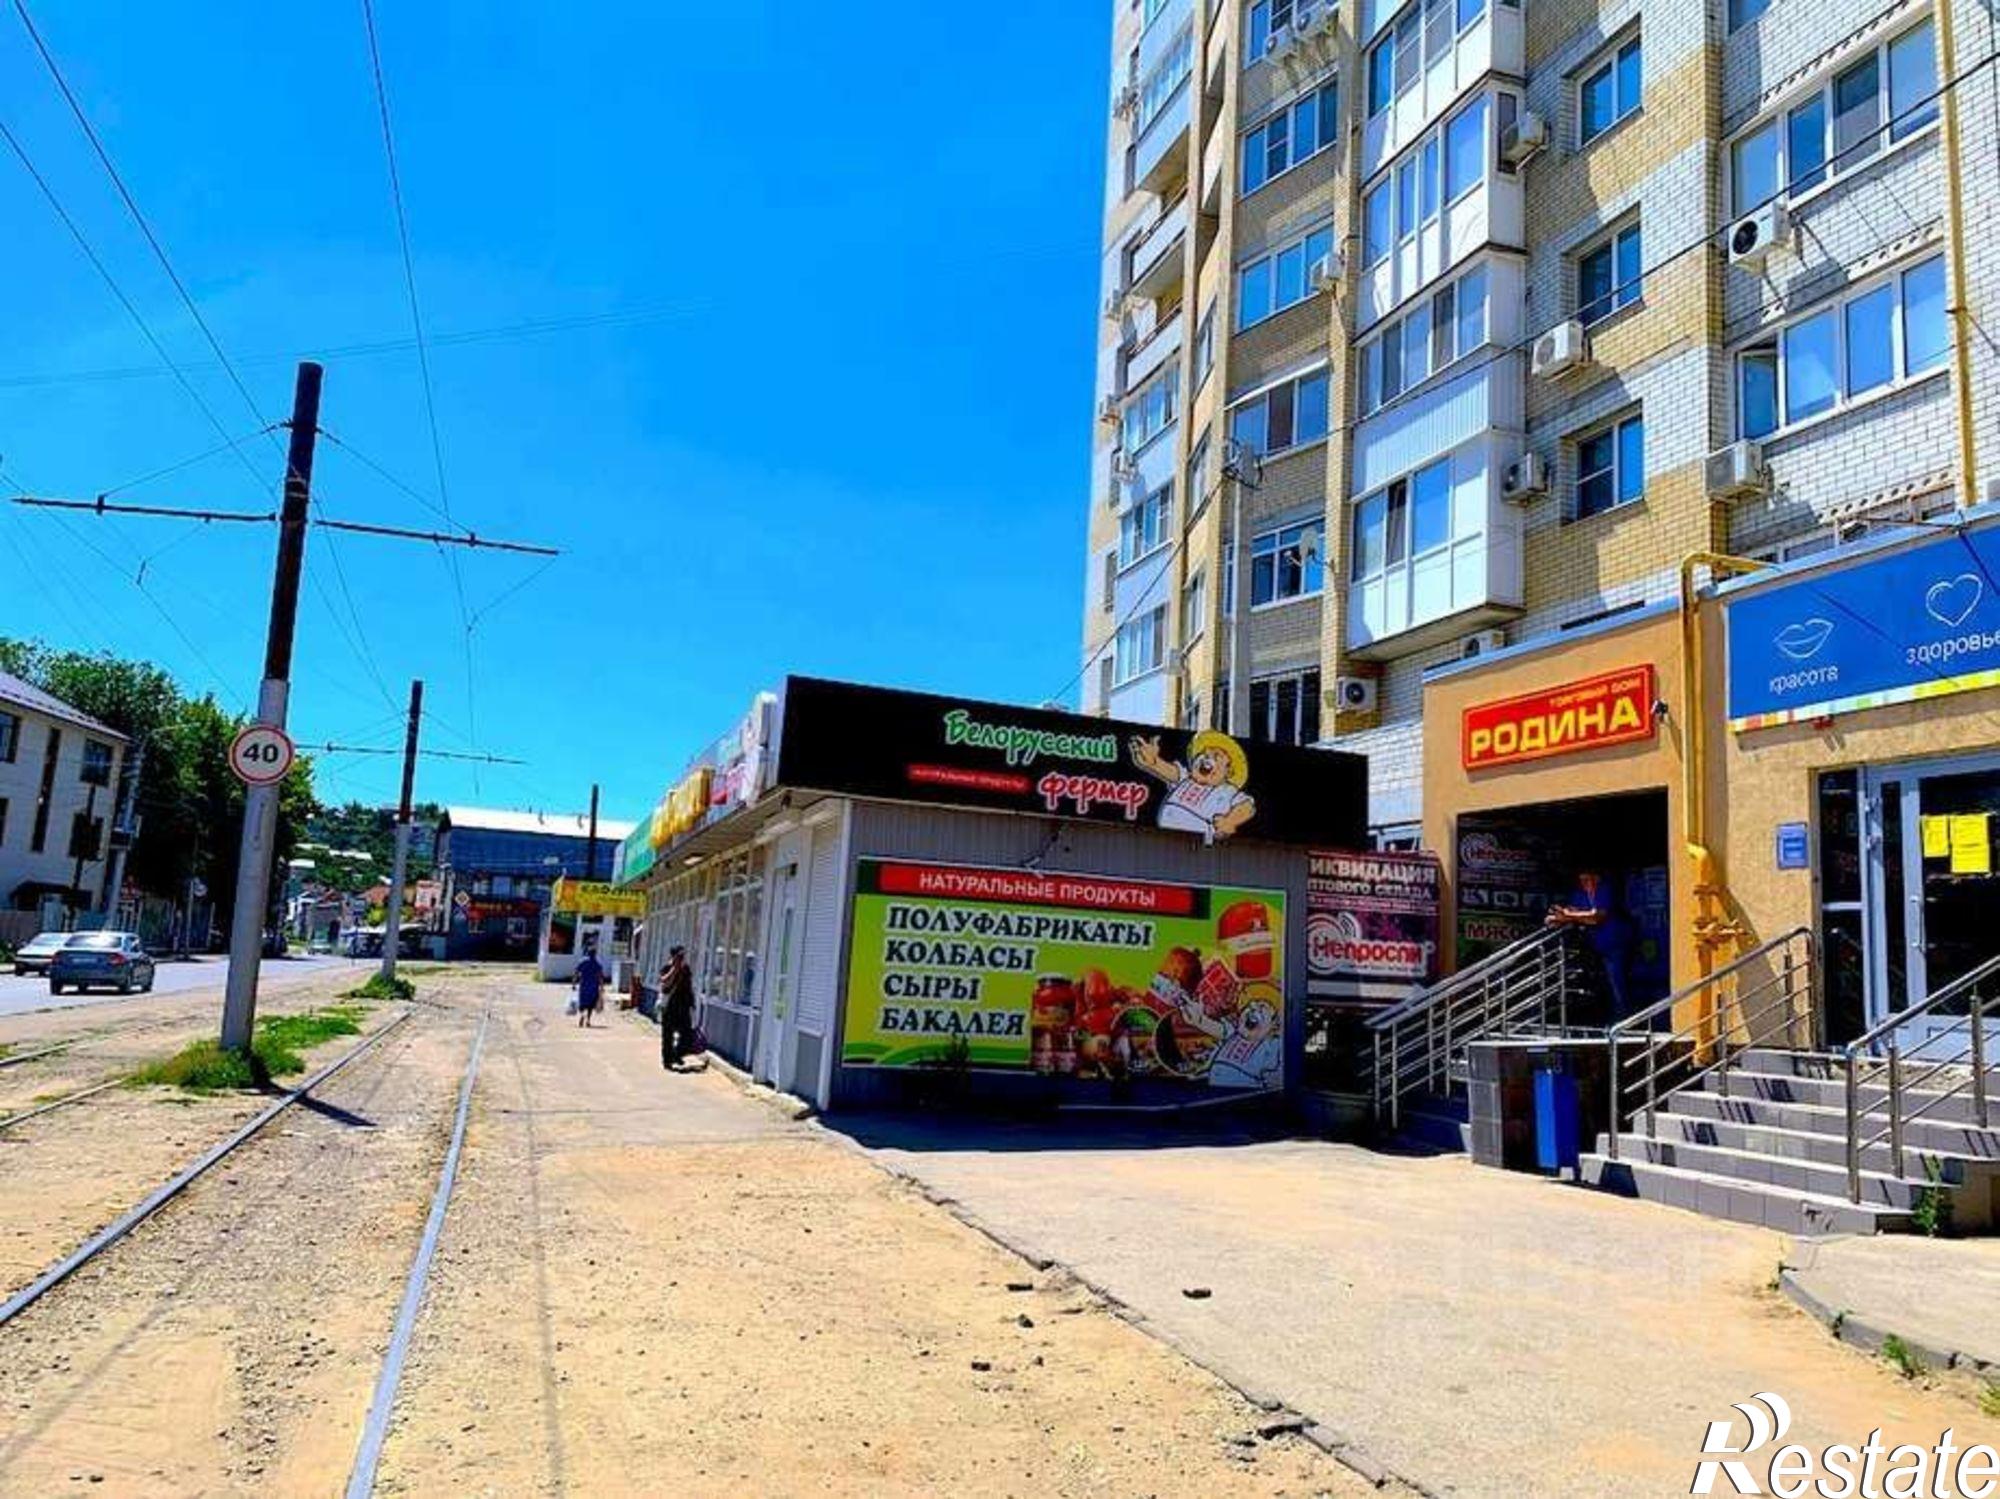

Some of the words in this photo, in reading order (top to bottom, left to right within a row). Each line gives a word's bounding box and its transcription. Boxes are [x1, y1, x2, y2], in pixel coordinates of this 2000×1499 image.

[1769, 666, 1839, 694] красота
[945, 710, 1118, 764] Белорусский
[1470, 695, 1641, 759] РОДИНА
[243, 744, 279, 762] 40
[1038, 772, 1149, 820] фермер
[1310, 858, 1436, 884] ИКВИДАЦИЯ
[919, 873, 1055, 898] НАТУРАЛЬНЫЕ
[1060, 882, 1156, 907] ПРОДУКТЫ
[1307, 880, 1372, 896] ПТОВОГО
[887, 904, 1153, 947] ПОЛУФАБРИКАТЫ
[885, 940, 1036, 970] КОЛБАСЫ
[883, 974, 981, 1000] СЫРЫ
[881, 1008, 1026, 1036] БАКАЛЕЯ
